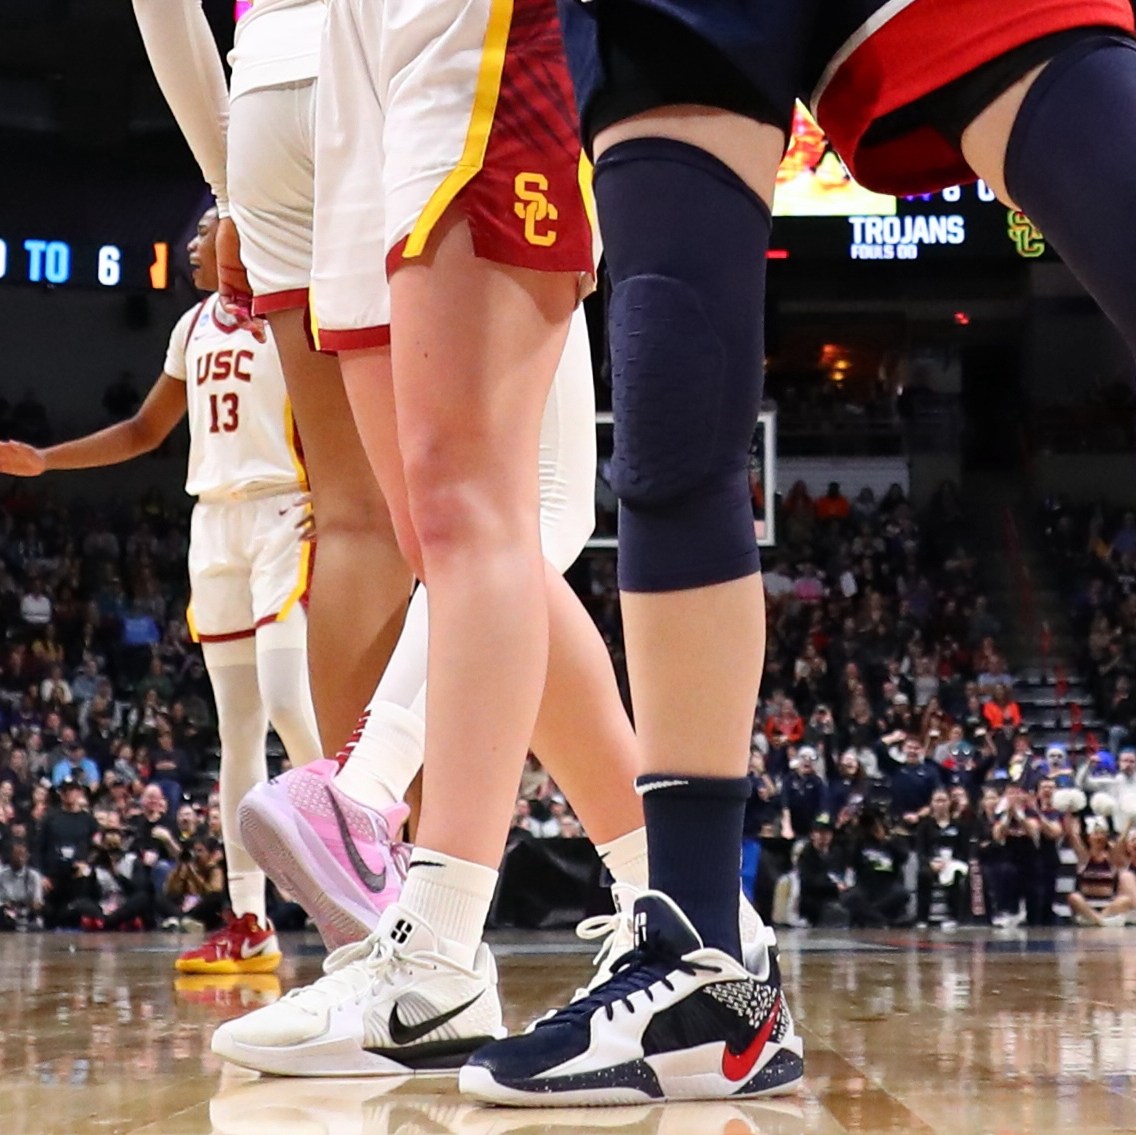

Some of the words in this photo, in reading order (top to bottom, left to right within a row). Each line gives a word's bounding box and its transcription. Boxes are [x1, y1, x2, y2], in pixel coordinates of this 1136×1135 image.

[848, 215, 965, 245] TROJANS
[25, 239, 70, 284] TO
[98, 245, 121, 286] 6
[851, 244, 895, 260] FOULS
[196, 349, 254, 386] USC
[208, 392, 240, 434] 13
